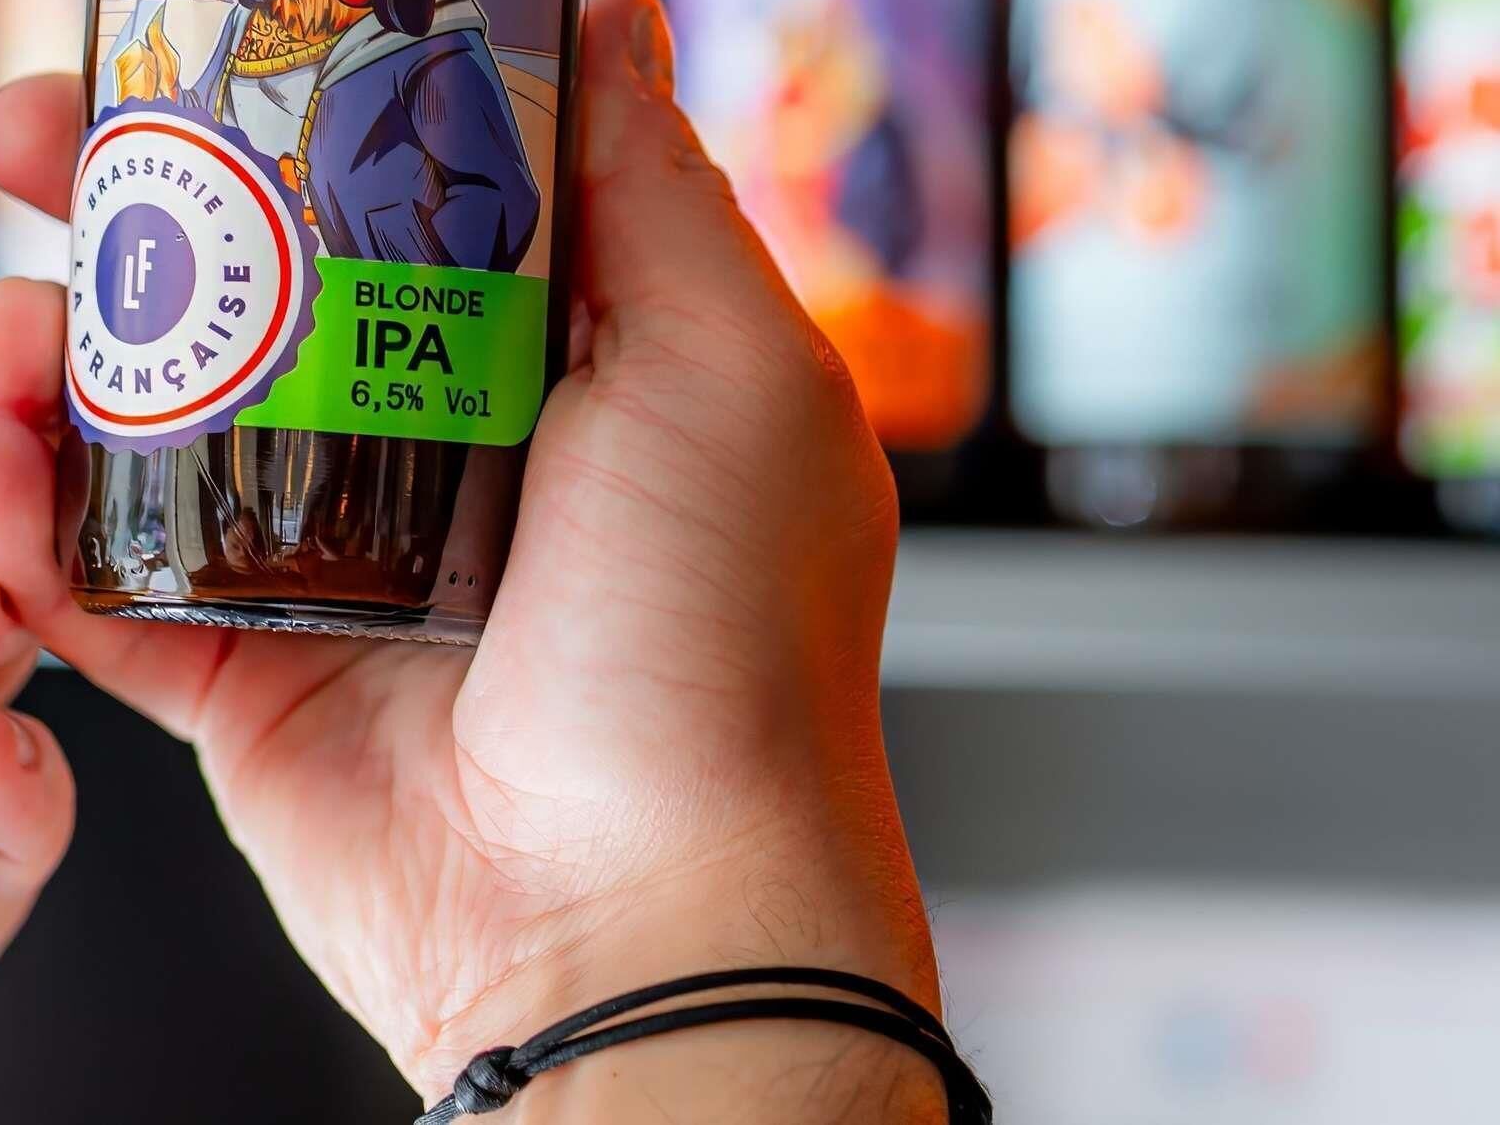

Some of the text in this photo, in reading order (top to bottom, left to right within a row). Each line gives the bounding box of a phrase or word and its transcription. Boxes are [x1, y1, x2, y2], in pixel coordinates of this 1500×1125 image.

[87, 157, 224, 215] BRASSERIE
[122, 238, 157, 310] LF
[355, 281, 485, 318] BLONDE
[79, 265, 251, 394] FRANÇAISE
[355, 318, 454, 375] IPA
[350, 380, 493, 417] 6,5% Vol
